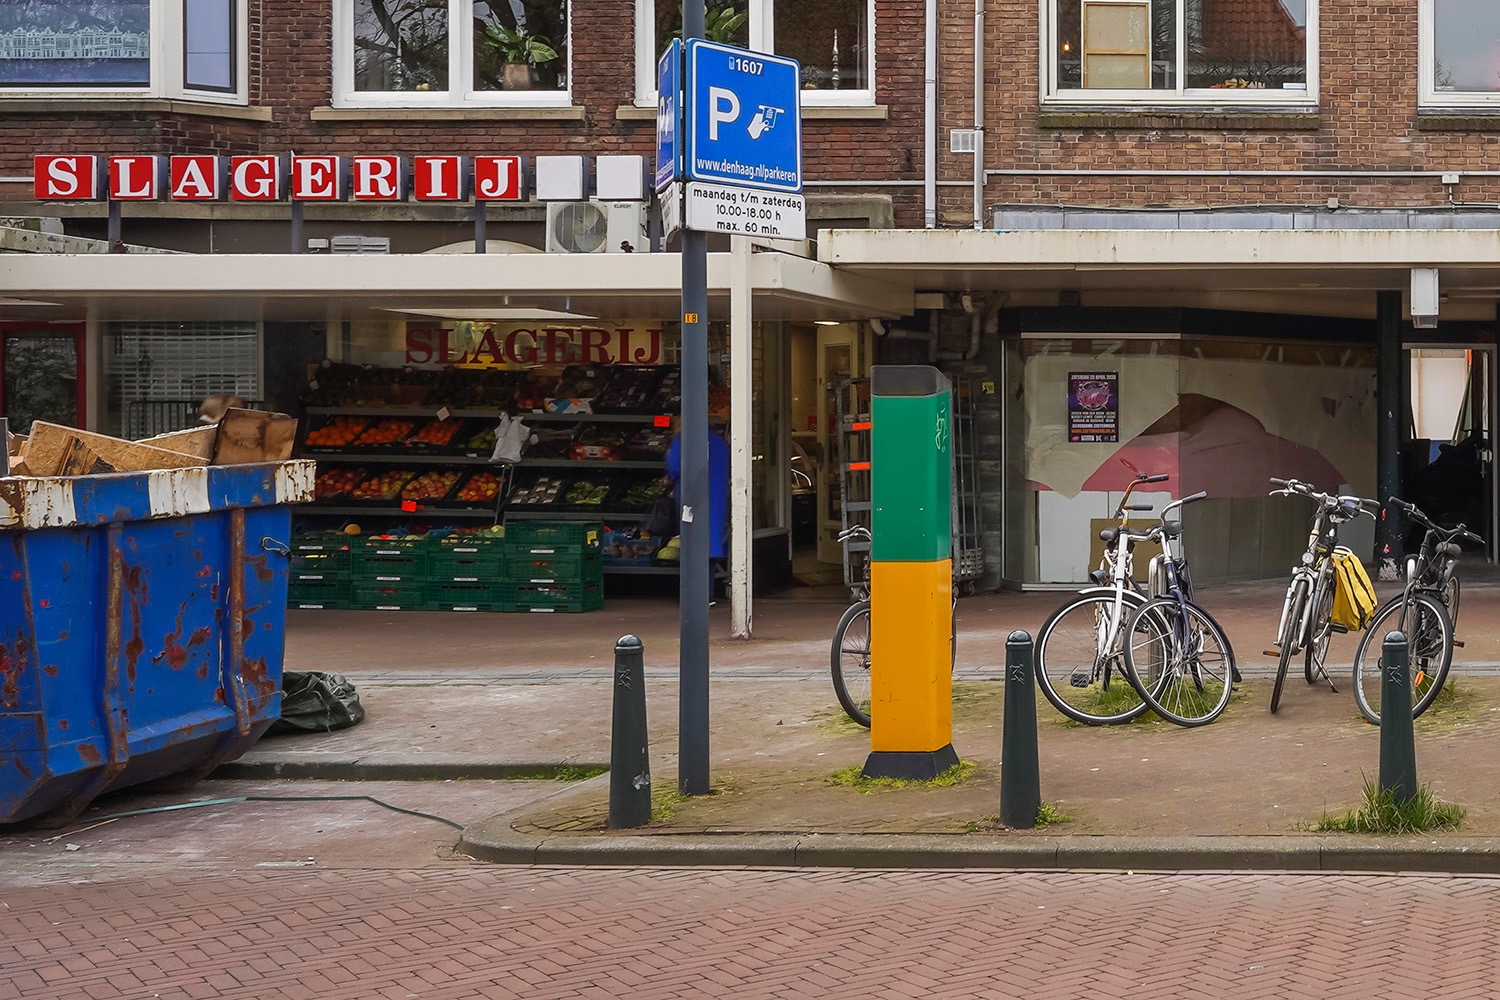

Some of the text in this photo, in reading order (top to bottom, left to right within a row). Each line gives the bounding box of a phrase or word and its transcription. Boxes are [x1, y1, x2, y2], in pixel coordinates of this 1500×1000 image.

[735, 58, 764, 76] 1607
[708, 85, 741, 141] P
[47, 157, 516, 198] SLAGERIJ
[696, 158, 797, 182] www.denhaag.nl/parkeren
[693, 188, 802, 212] maandag t/m zaterdag
[716, 204, 781, 221] 10.00-18.00 h
[716, 221, 781, 235] max. 60 min.
[686, 314, 697, 323] 18
[405, 328, 662, 364] SLAGERIJ
